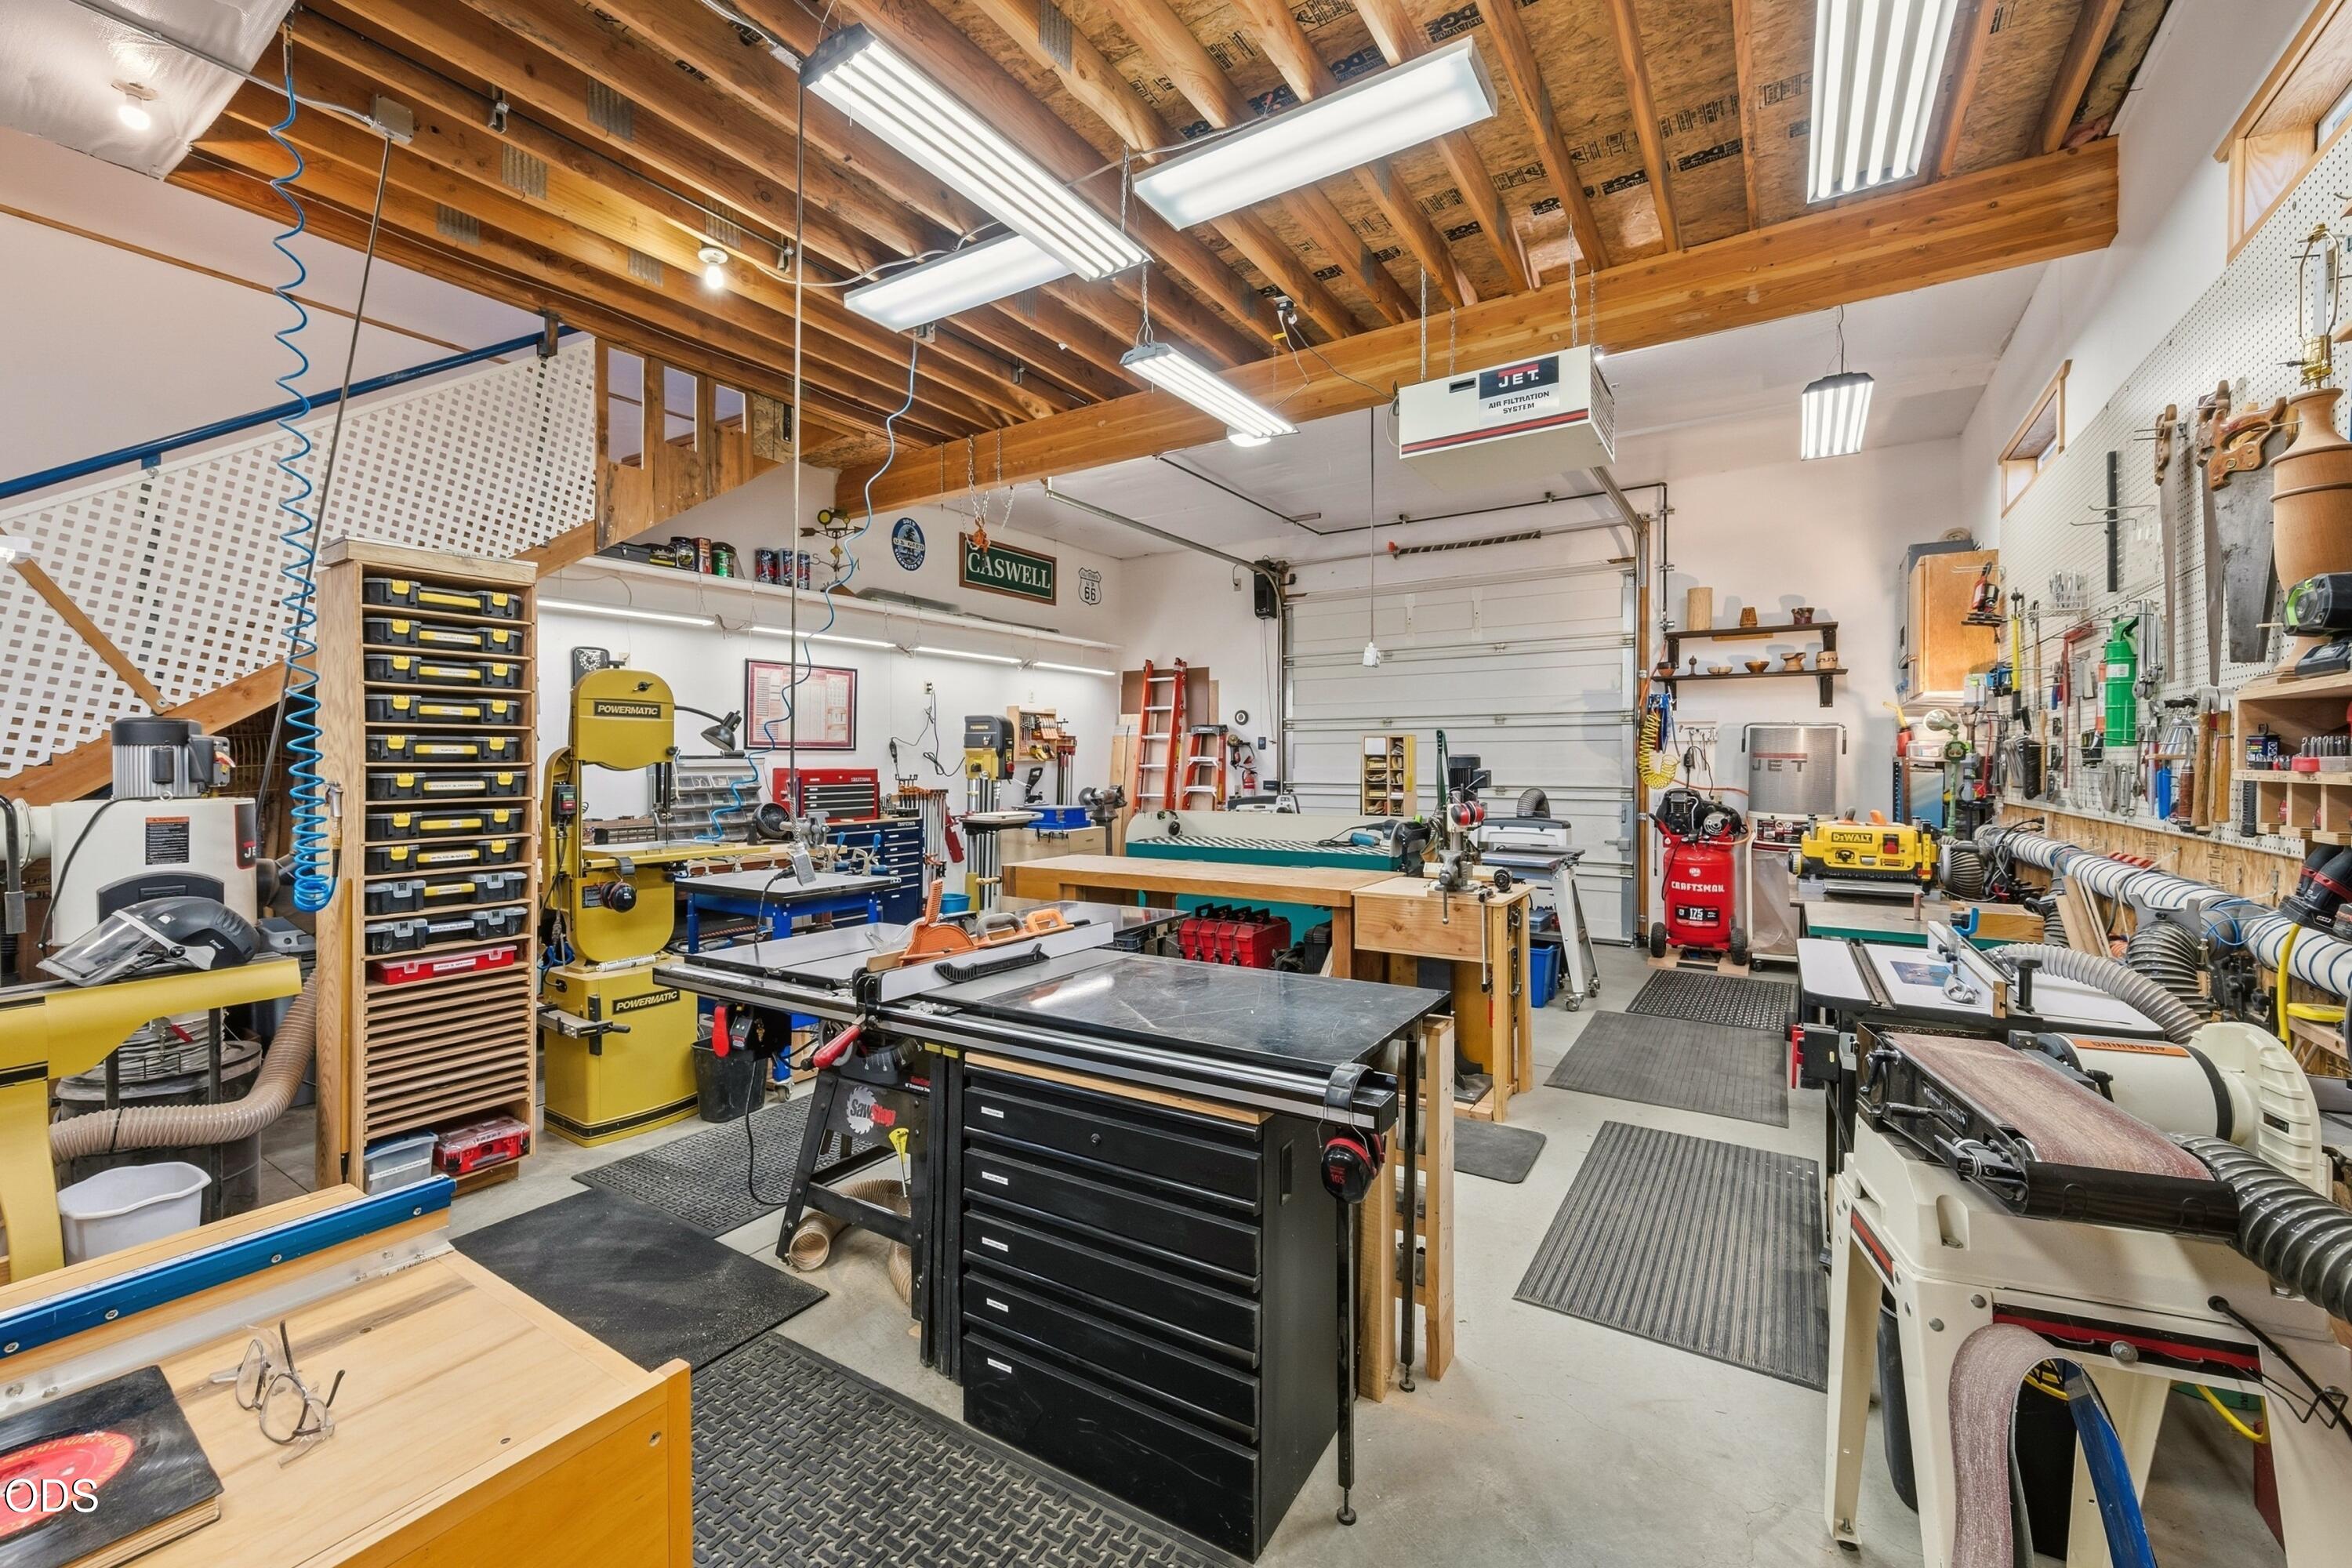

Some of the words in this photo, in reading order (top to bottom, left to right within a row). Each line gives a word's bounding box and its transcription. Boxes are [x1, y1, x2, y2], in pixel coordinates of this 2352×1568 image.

[1488, 401, 1501, 409] AIR
[1503, 390, 1550, 405] FILTRATION
[1503, 402, 1535, 414] SYSTEM
[967, 552, 1051, 590] CASWELL
[1084, 586, 1096, 601] 66
[597, 705, 658, 715] POWERMATIC
[1752, 759, 1807, 772] JET
[1671, 880, 1725, 892] CRAFTSMAN
[615, 990, 677, 1011] POWERMATIC
[850, 1098, 896, 1127] SawStop
